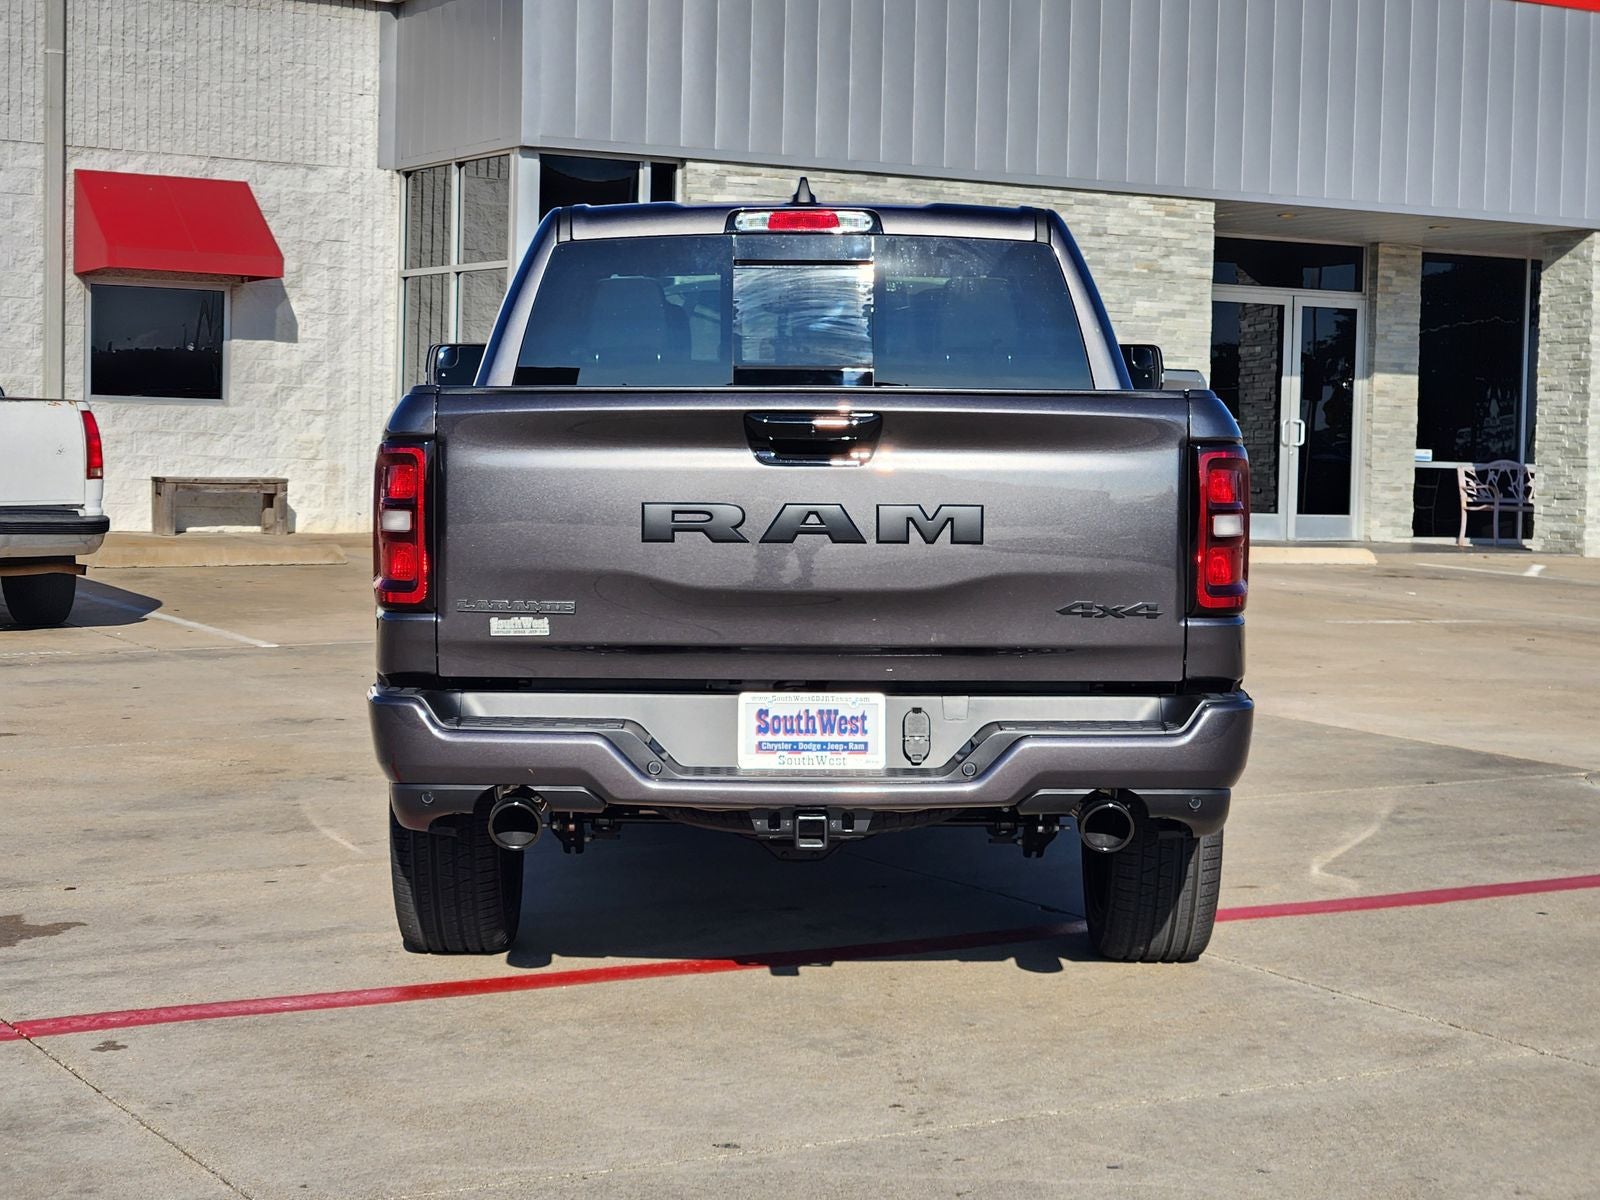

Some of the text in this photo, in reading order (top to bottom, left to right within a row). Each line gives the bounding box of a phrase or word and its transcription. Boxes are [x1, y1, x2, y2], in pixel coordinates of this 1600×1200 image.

[641, 502, 984, 544] RAM
[456, 599, 576, 614] LARAMIE
[755, 708, 868, 736] SouthWest
[761, 742, 792, 751] Chrysler
[798, 742, 821, 751] Dodge
[827, 742, 844, 751] Jeep
[778, 755, 847, 766] SouthWest
